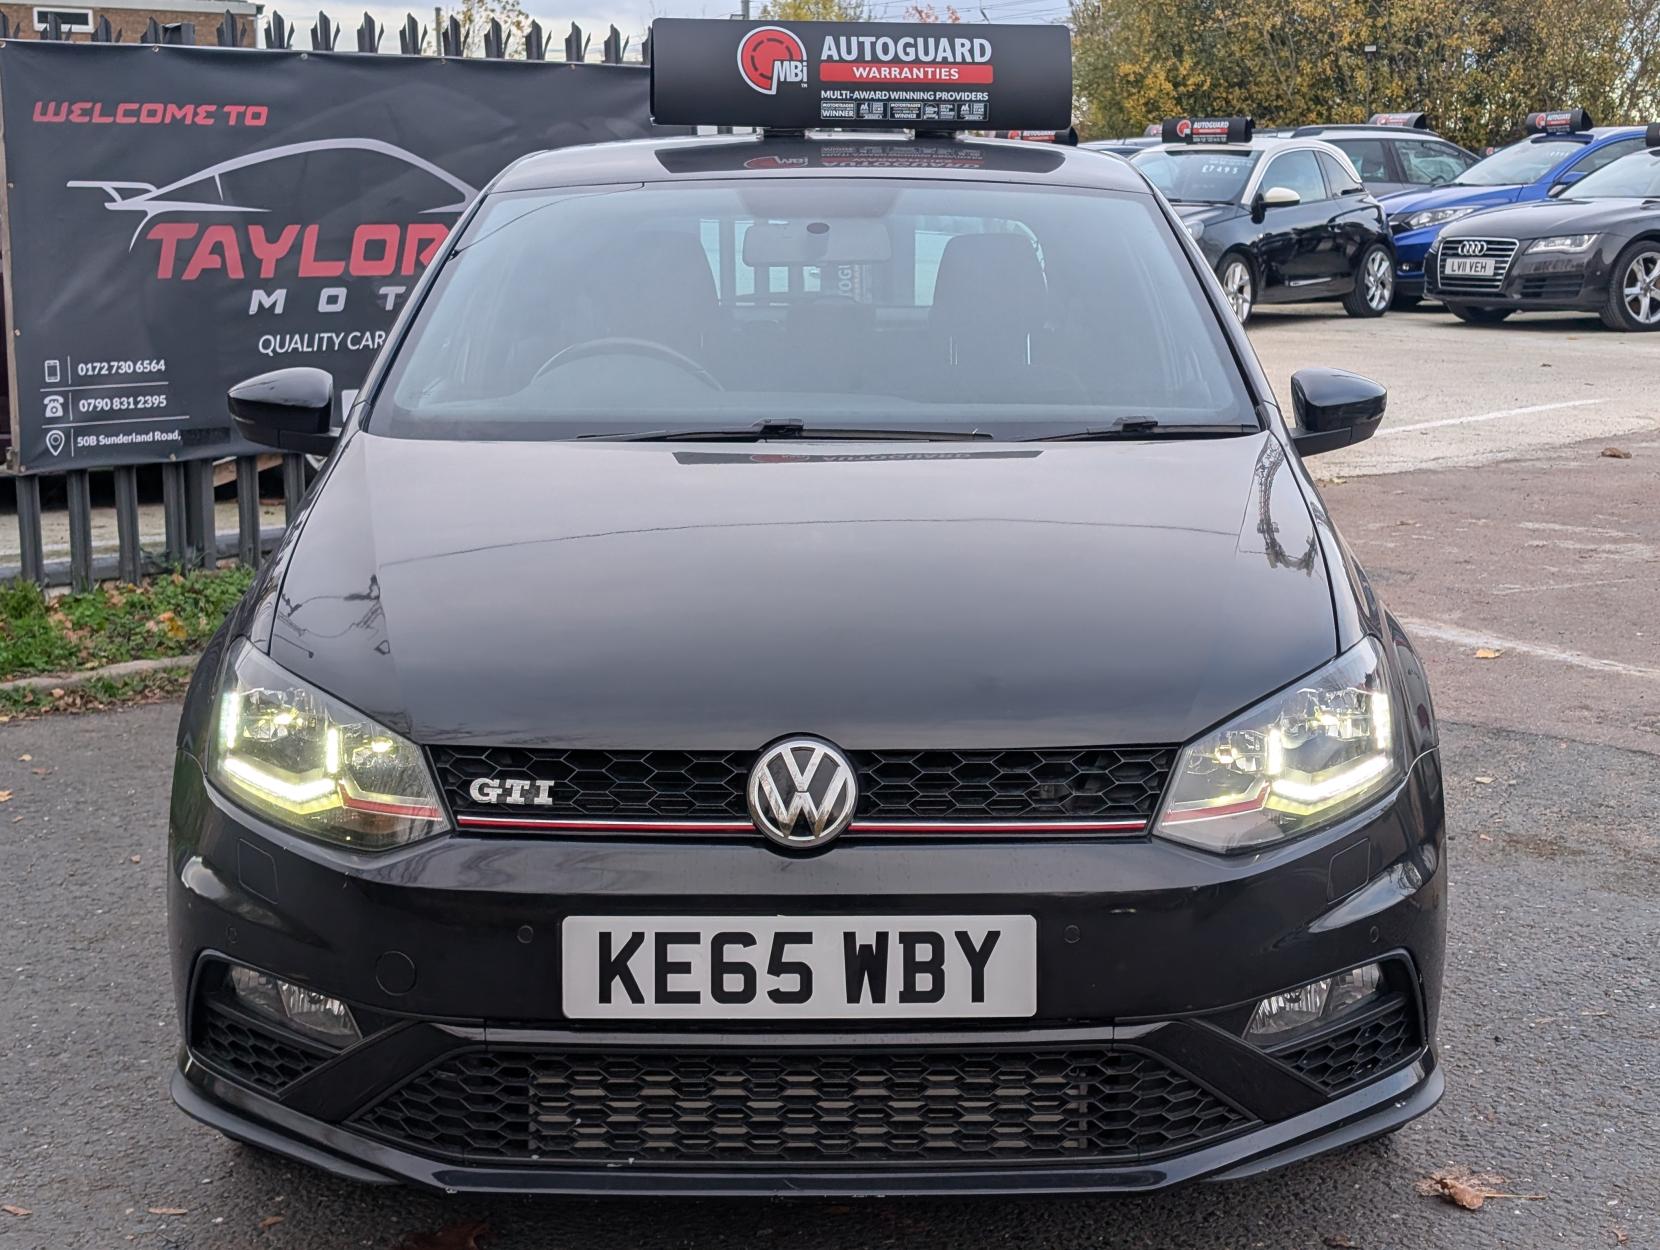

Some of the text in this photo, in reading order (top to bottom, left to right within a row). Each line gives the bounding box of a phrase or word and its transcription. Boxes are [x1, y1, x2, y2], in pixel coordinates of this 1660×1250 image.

[821, 35, 992, 63] AUTOGUARD
[853, 66, 959, 80] WARRANTIES
[821, 90, 989, 101] MULTI-AWARD WINNING PROVIDERS
[33, 101, 268, 126] WELCOME TO
[1469, 262, 1487, 273] VEH
[259, 332, 345, 356] QUALITY
[78, 359, 166, 376] 0172 730 6564
[79, 395, 167, 412] 0790 831 2395
[77, 434, 97, 447] 50B
[99, 431, 153, 445] Sunderland
[469, 777, 554, 805] GTI
[598, 930, 1001, 1005] KE65 WBY
